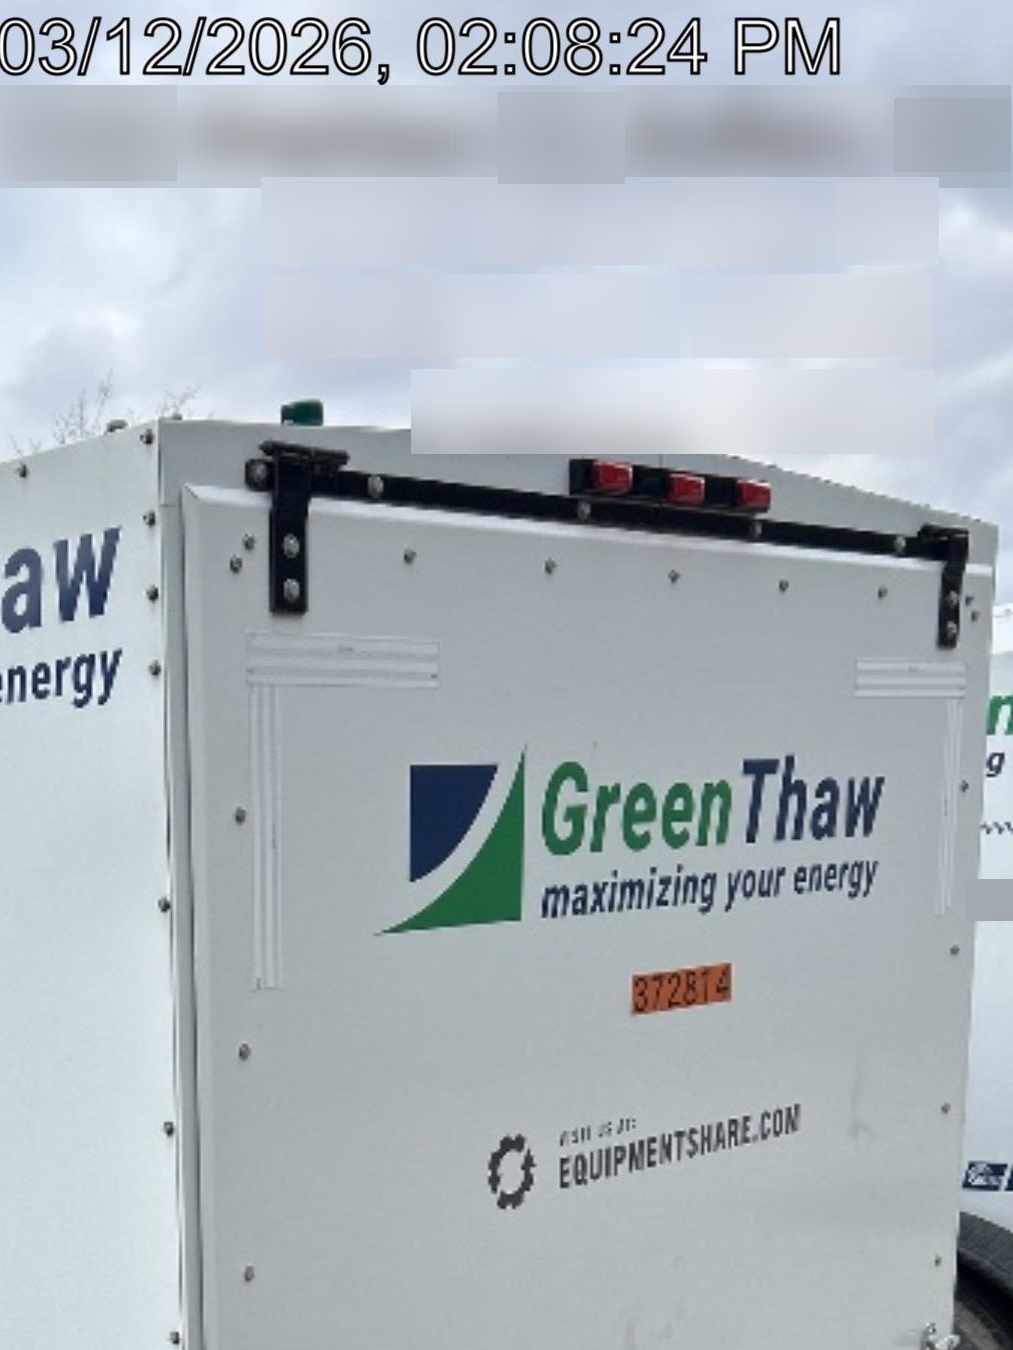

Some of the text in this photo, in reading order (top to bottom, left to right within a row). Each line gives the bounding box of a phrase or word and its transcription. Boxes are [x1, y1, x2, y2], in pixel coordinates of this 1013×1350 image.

[541, 861, 879, 919] maximizing your energy
[633, 968, 730, 1013] 372814
[559, 1104, 800, 1189] EQUIPMENTSHARE.COM
